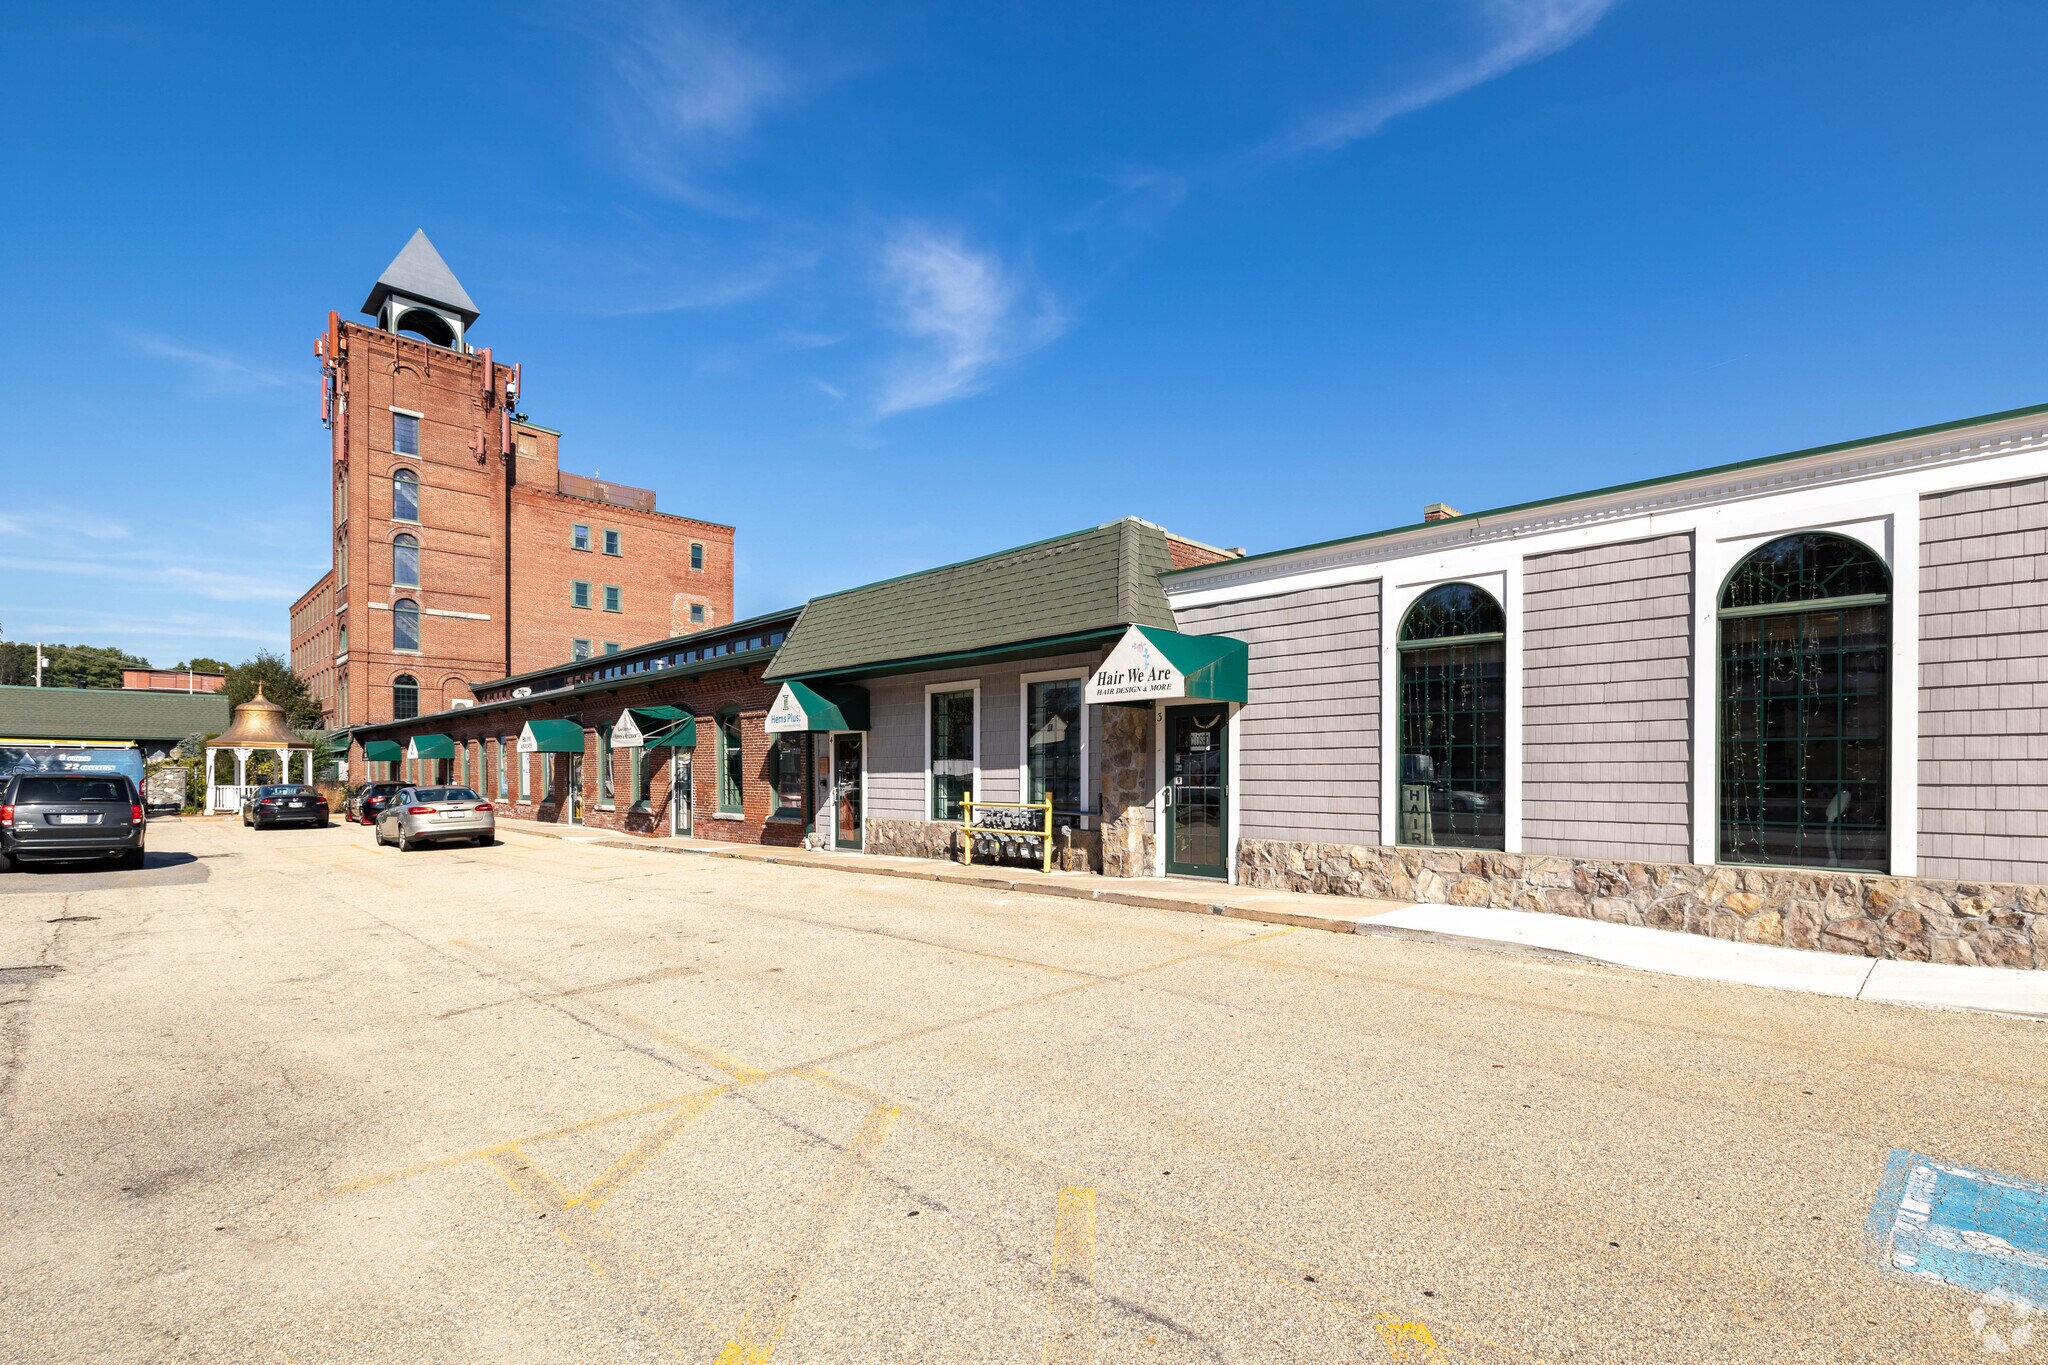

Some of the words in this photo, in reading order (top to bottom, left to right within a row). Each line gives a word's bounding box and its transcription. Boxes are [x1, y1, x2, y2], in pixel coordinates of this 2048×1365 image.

[1096, 670, 1124, 686] Hair
[1128, 668, 1144, 683] We
[1147, 666, 1171, 682] Are
[1096, 688, 1115, 696] HAIR
[1115, 686, 1141, 695] DESIGN
[1150, 683, 1172, 691] MORE
[771, 715, 787, 724] Hems
[1157, 712, 1163, 722] 3
[1410, 790, 1422, 843] HAIR
